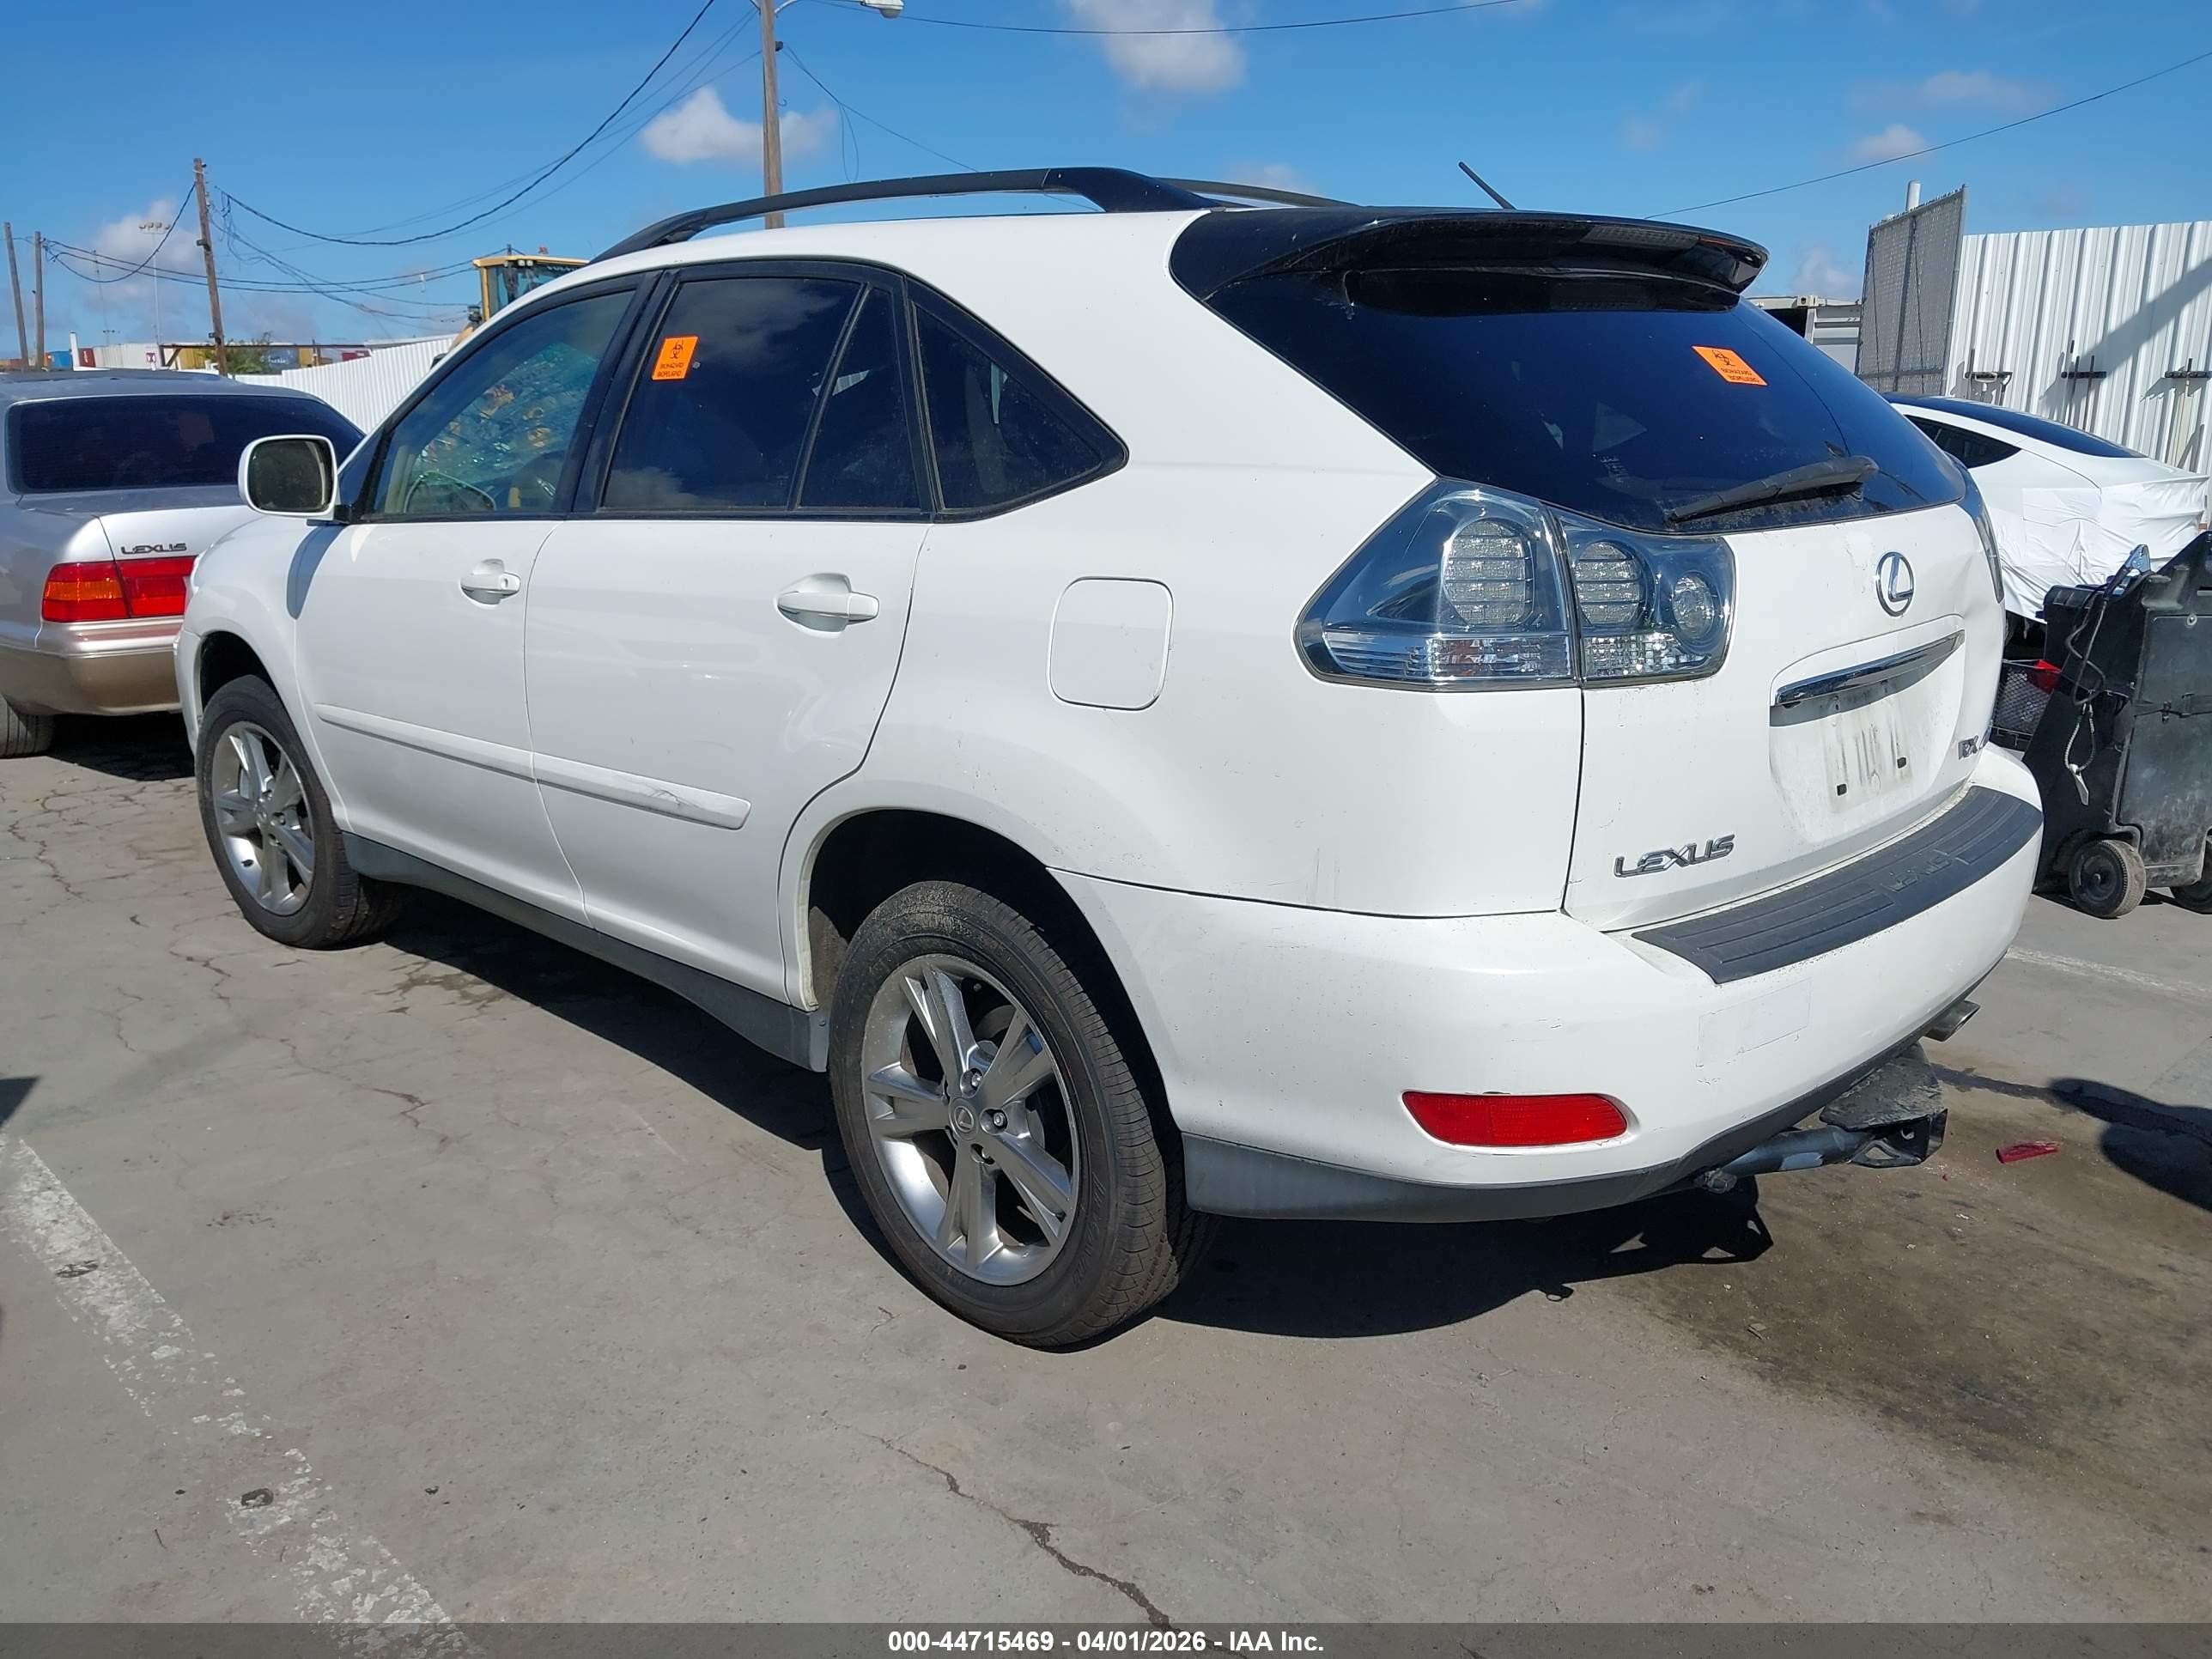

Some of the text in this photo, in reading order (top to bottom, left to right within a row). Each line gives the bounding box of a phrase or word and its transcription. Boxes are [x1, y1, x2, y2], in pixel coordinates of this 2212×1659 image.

[120, 543, 187, 555] LEXUS
[1613, 834, 1735, 878] LEXUS
[1881, 857, 1951, 890] LEXUS
